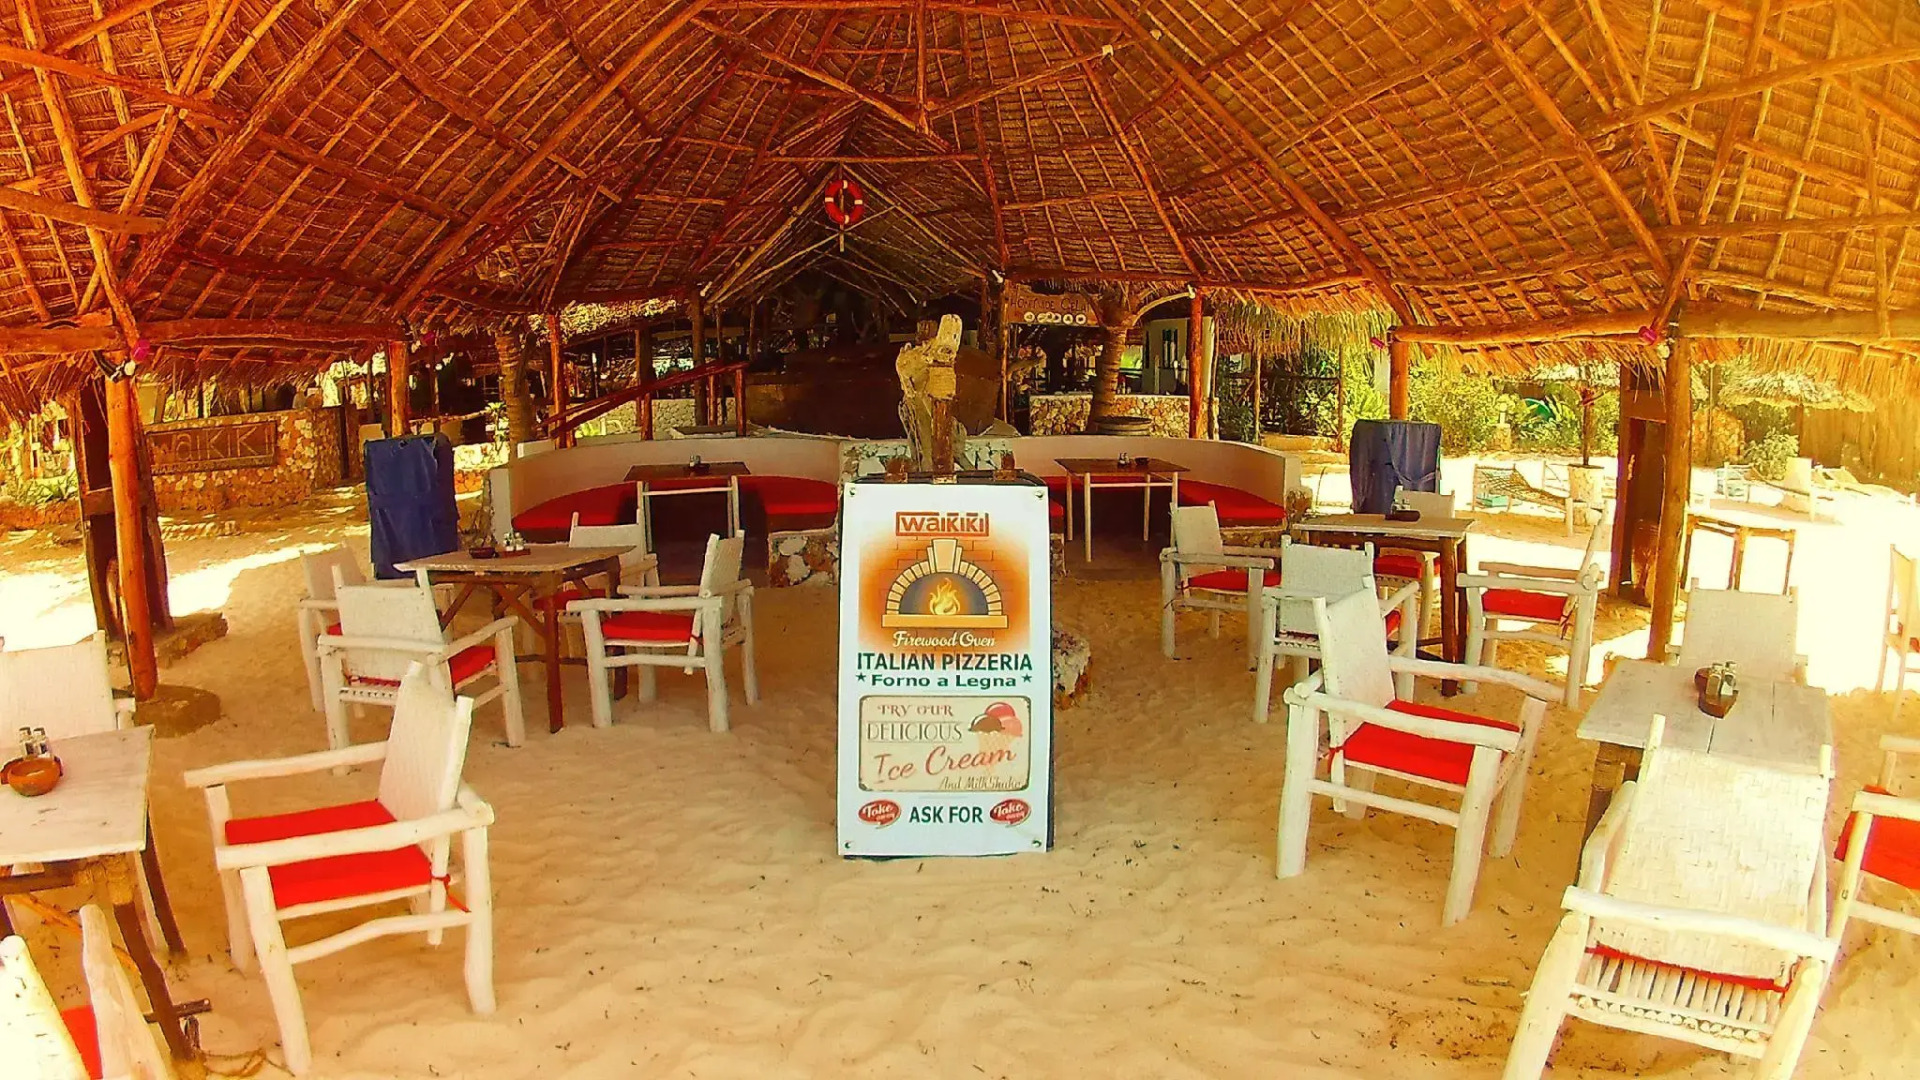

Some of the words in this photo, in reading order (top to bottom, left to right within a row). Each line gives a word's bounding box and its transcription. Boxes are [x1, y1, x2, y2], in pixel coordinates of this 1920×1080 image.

[892, 630, 957, 648] Firewood
[959, 631, 995, 647] Oven
[857, 652, 935, 671] ITALIAN
[942, 653, 1033, 671] PIZZERIA
[871, 674, 930, 687] Forno
[937, 676, 949, 687] a
[956, 674, 1017, 690] Legna
[877, 704, 912, 717] TRY
[917, 705, 954, 717] OUR
[867, 722, 962, 741] DELICIOUS
[874, 753, 916, 784] Ice
[925, 745, 1017, 776] Cream
[939, 776, 962, 790] And
[909, 806, 944, 824] ASK
[949, 806, 983, 824] FOR
